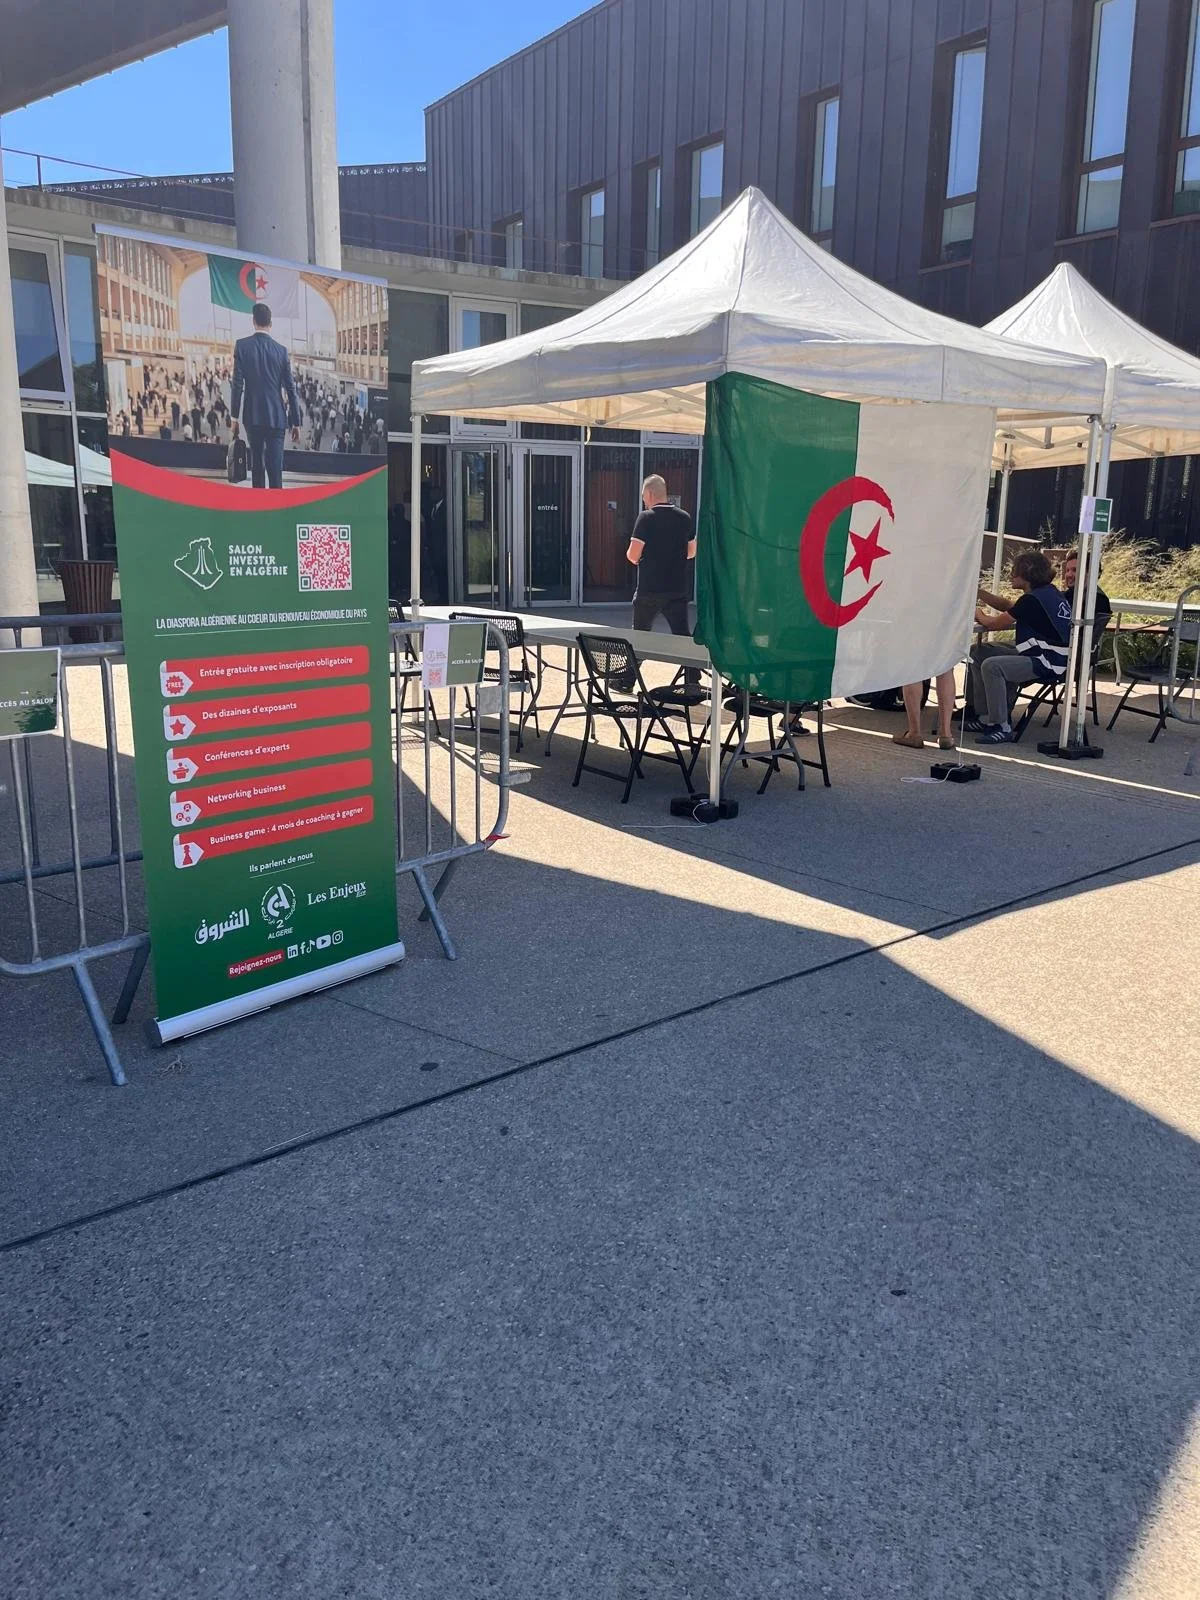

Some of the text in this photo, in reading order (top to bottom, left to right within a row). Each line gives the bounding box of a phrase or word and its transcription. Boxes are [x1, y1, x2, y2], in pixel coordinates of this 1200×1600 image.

[228, 544, 262, 554] SALON
[229, 555, 276, 566] INVESTIR
[229, 563, 288, 576] EN ALGÉRIE
[156, 608, 367, 629] LA DIASPORA ALGÉRIENNE AU COEUR DU RENOUVEAU ÉCONOMIQUE DU PAYS
[199, 656, 353, 677] Entrée gratuite avec inscription obligatoire
[167, 680, 182, 688] FREE
[0, 697, 54, 708] CCÈS AU SALON
[202, 702, 297, 720] Des dizaines d'exposants
[204, 743, 290, 762] Conférences d'experts
[207, 783, 286, 804] Networking business
[210, 832, 243, 845] Business
[244, 828, 266, 840] game
[271, 824, 277, 832] 4
[277, 820, 295, 831] mois
[295, 818, 305, 827] de
[305, 812, 336, 825] coaching
[336, 810, 341, 818] à
[341, 806, 364, 819] gagner
[249, 852, 314, 873] Ils parlent de nous
[307, 881, 367, 906] Les Enjeux
[194, 907, 250, 945] الشروق
[267, 926, 294, 940] ALGERIE
[276, 919, 285, 929] 2
[229, 952, 282, 975] Rejoignez-nous
